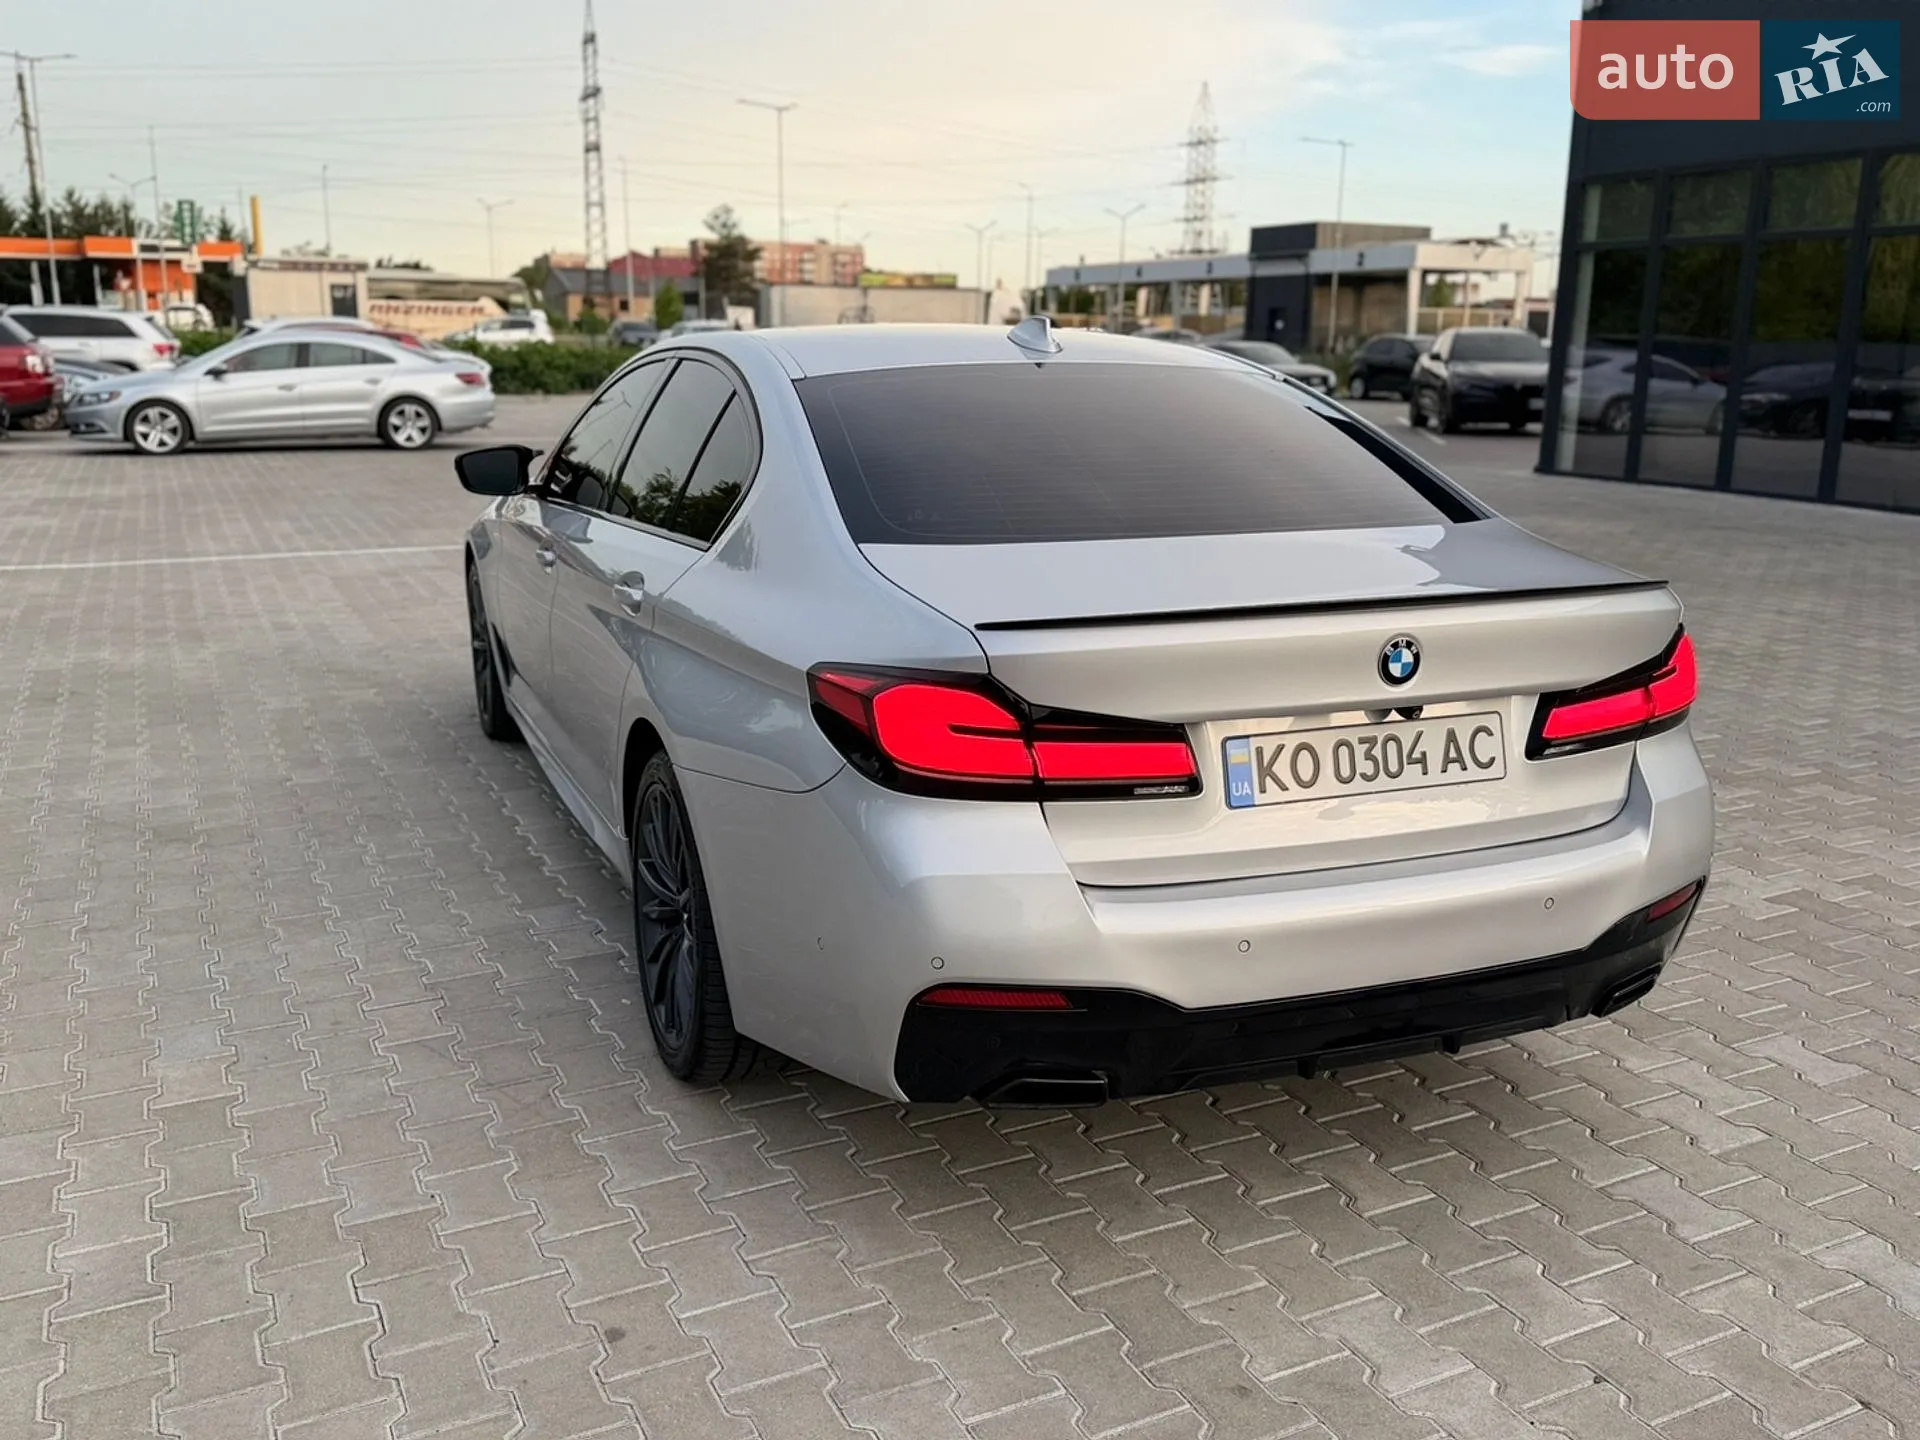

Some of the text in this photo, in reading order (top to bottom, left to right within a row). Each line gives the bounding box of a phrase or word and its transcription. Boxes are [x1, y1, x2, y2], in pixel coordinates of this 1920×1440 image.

[1255, 725, 1496, 794] KO 0304 AC
[1232, 781, 1252, 797] UA
